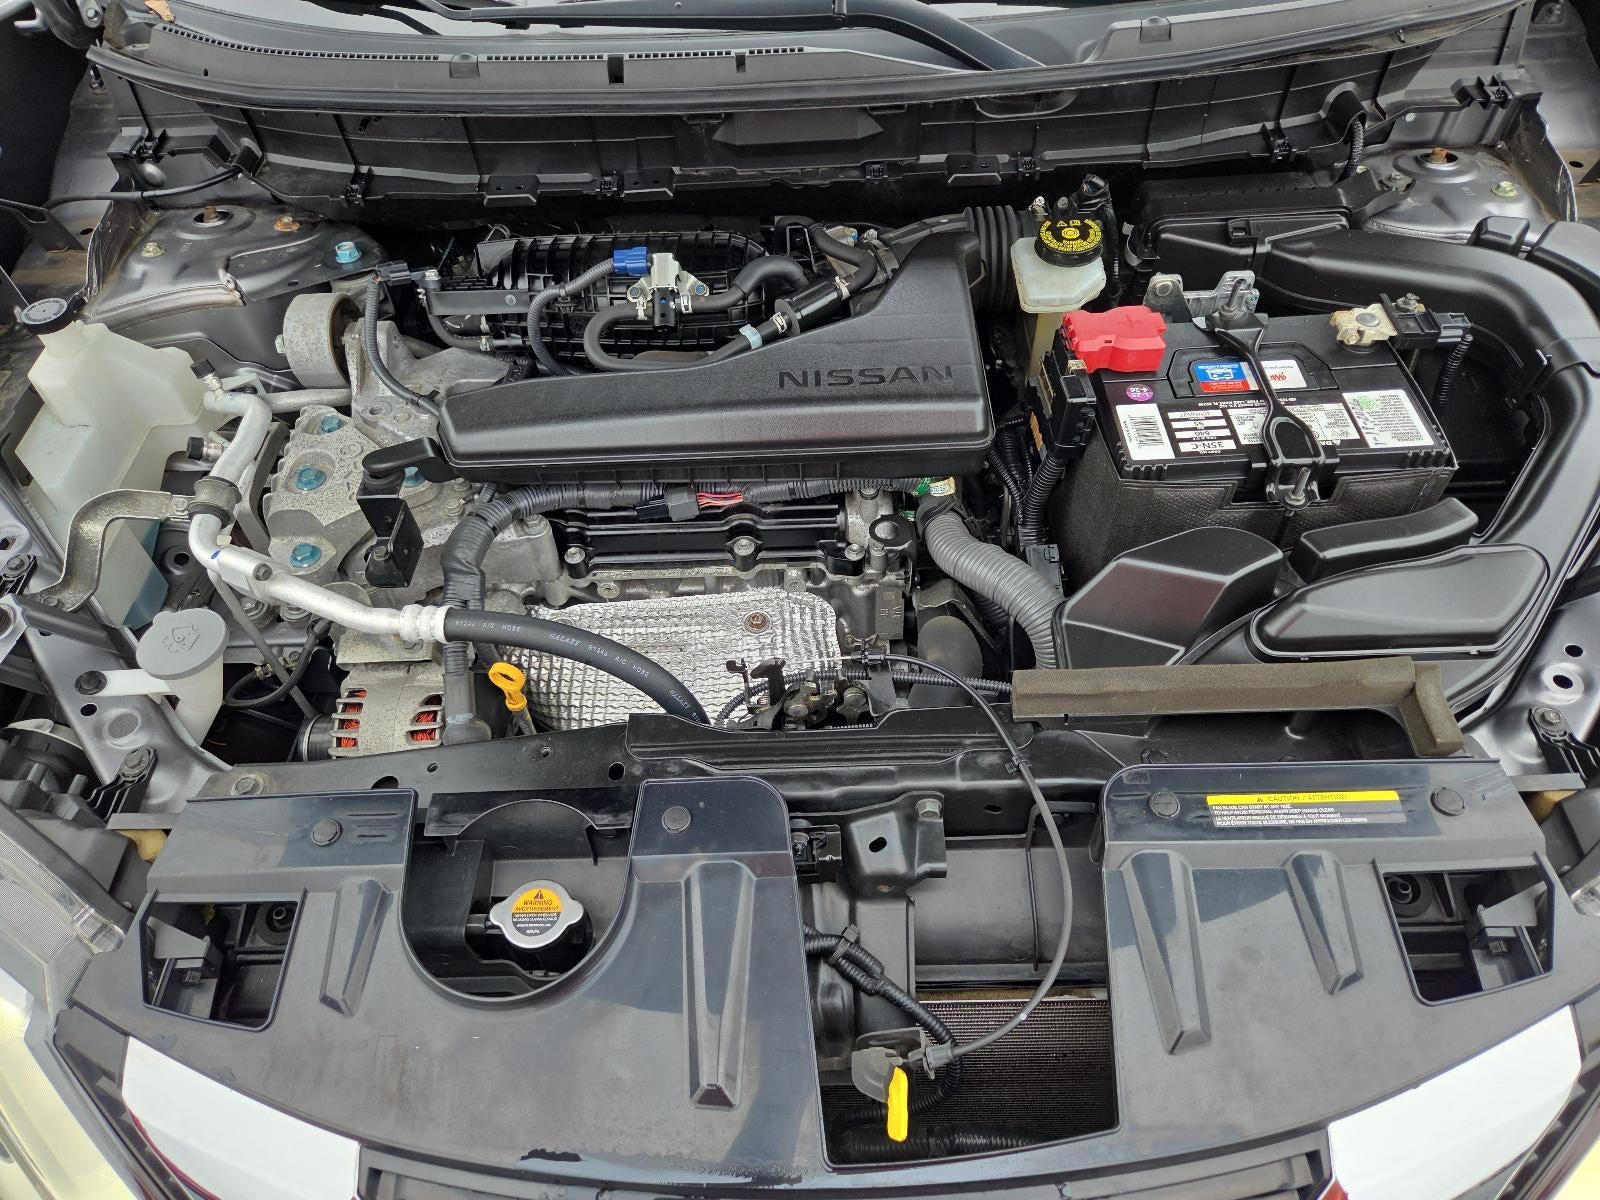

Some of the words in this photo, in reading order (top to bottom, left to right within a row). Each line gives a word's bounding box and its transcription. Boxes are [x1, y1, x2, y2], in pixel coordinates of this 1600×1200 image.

[778, 365, 953, 389] NISSAN
[1190, 441, 1224, 450] 35N-C
[501, 624, 521, 632] HOSE
[549, 633, 581, 646] GALAXY
[632, 664, 650, 678] HOSE
